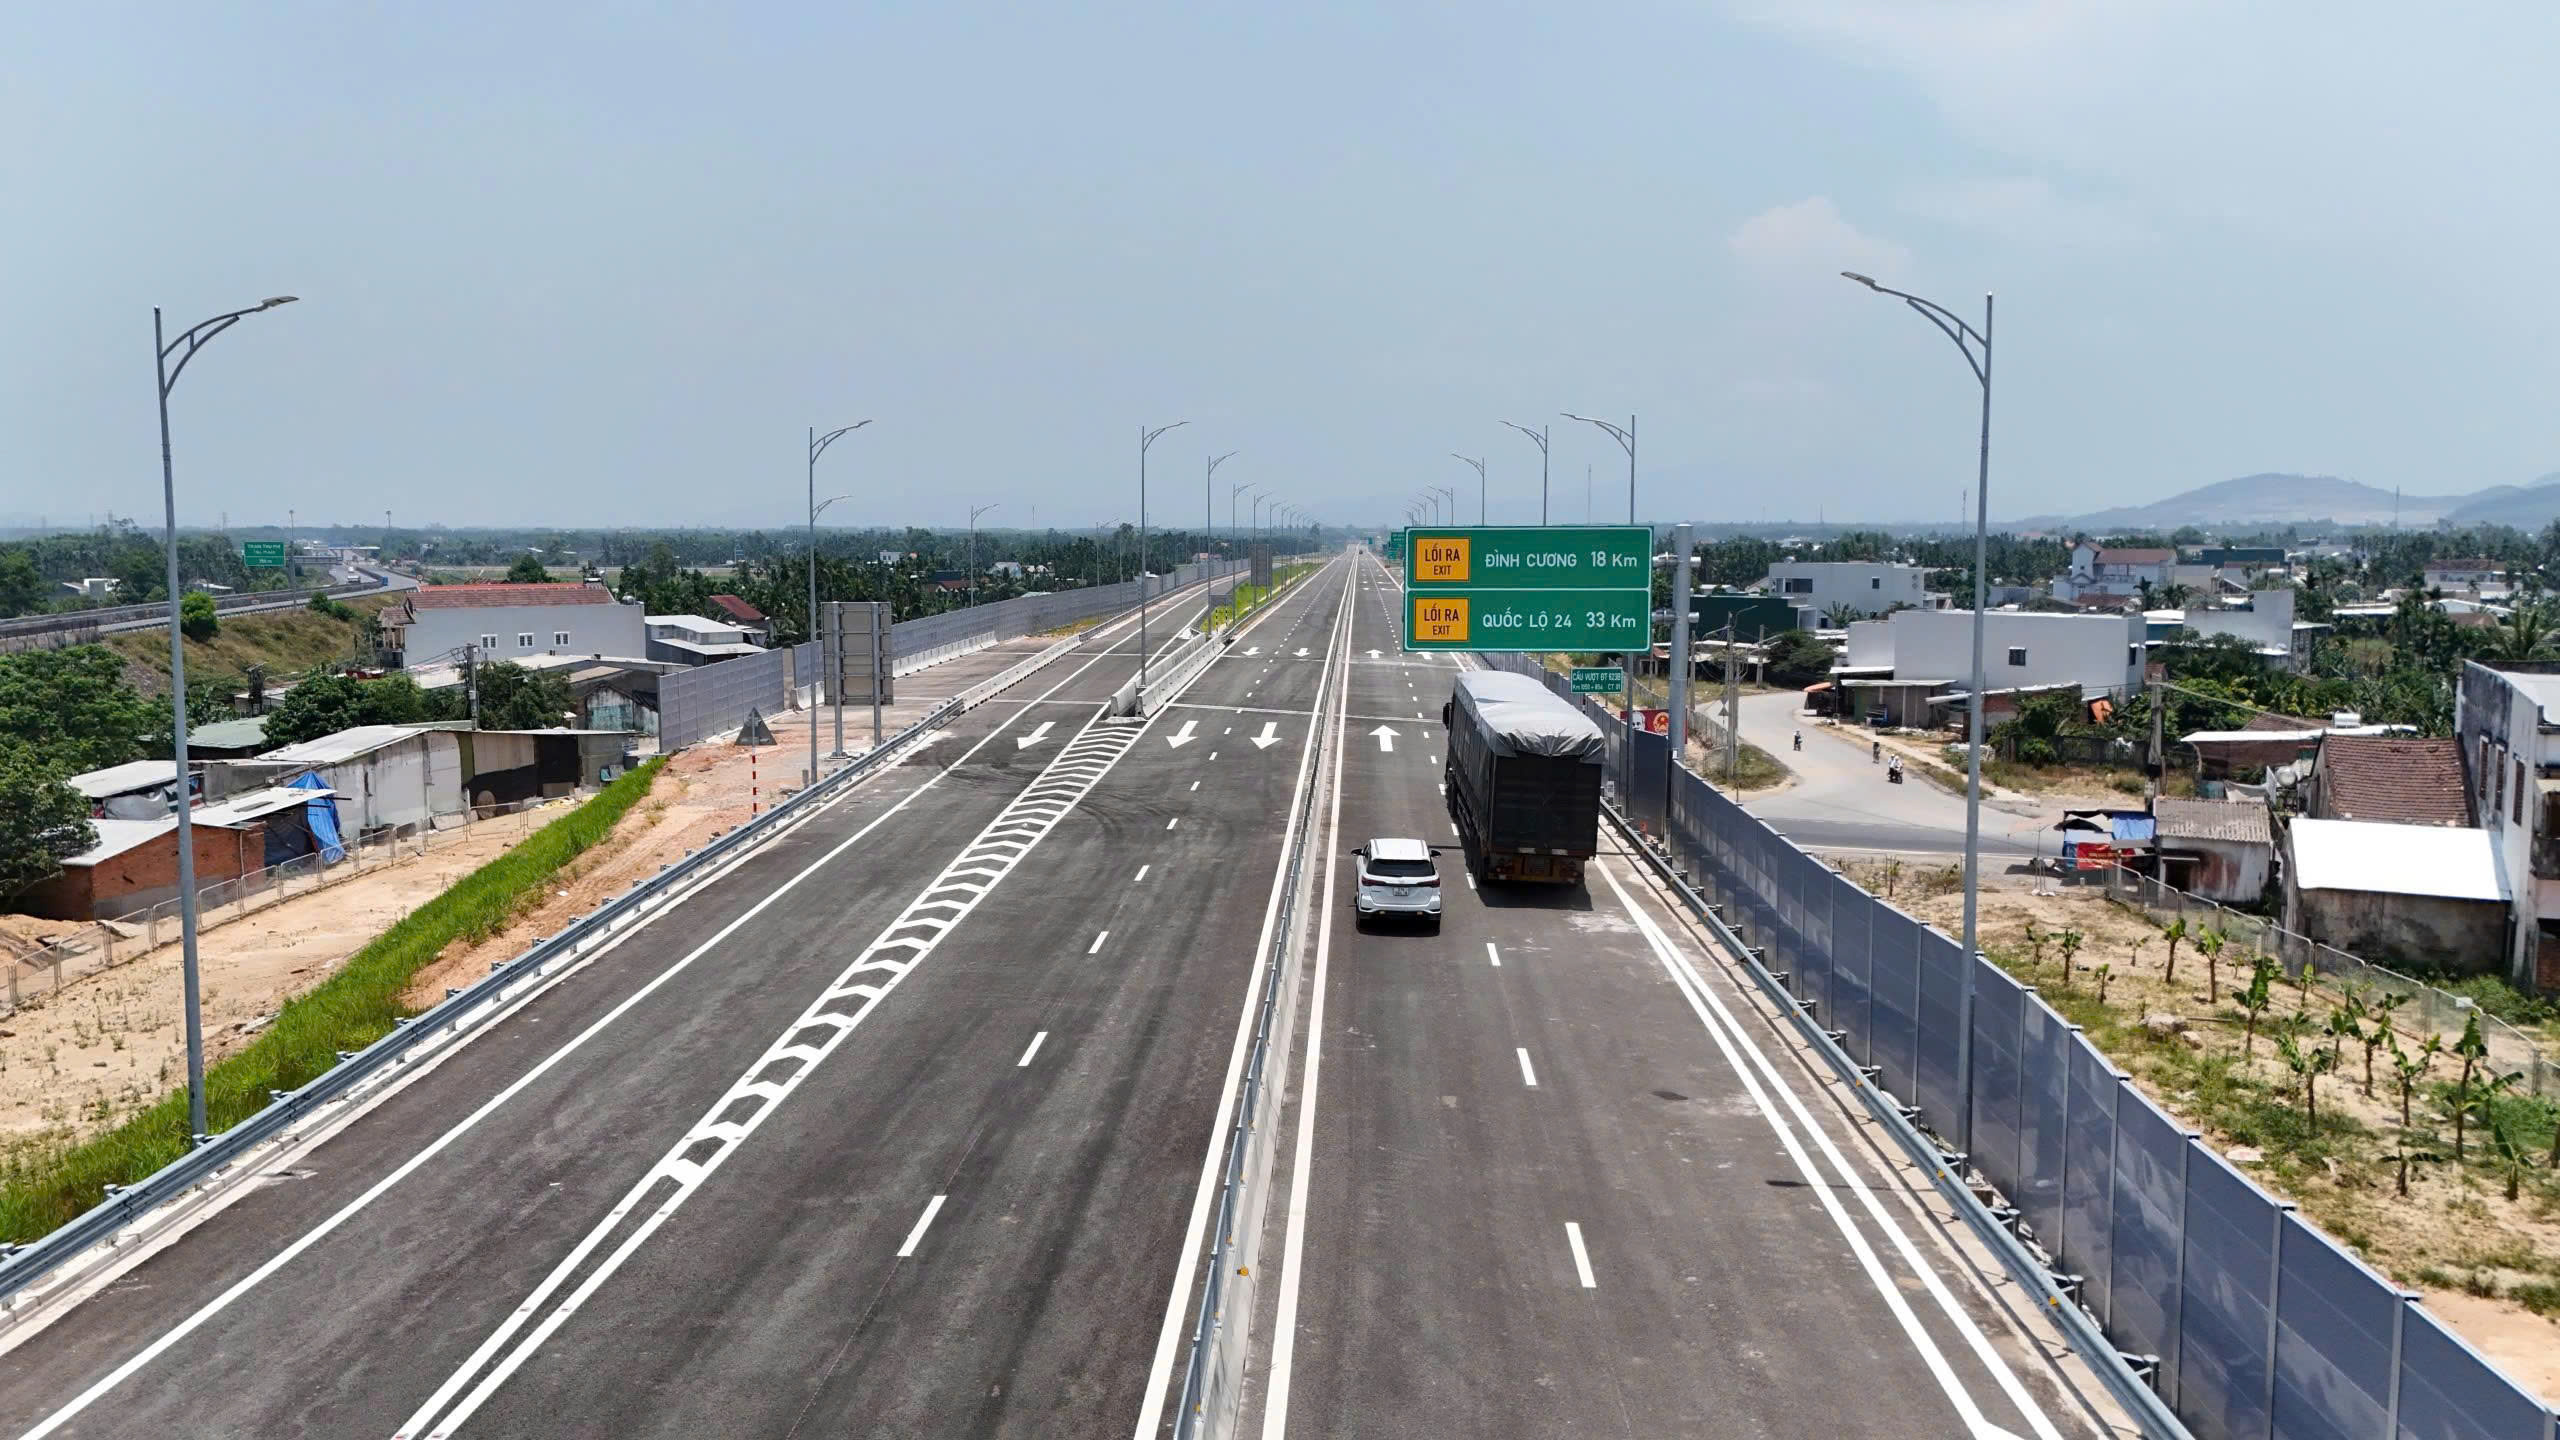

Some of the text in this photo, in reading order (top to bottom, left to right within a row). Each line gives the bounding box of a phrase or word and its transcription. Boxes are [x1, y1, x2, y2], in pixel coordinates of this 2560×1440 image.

[1425, 543, 1460, 561] LỐI RA
[1485, 549, 1638, 568] ĐÌNH CƯƠNG 18 Km
[1433, 565, 1452, 576] EXIT
[1424, 603, 1460, 621] LỐI RA
[1482, 607, 1636, 631] QUỐC LỘ 24 33 Km
[1432, 625, 1450, 636] EXIT
